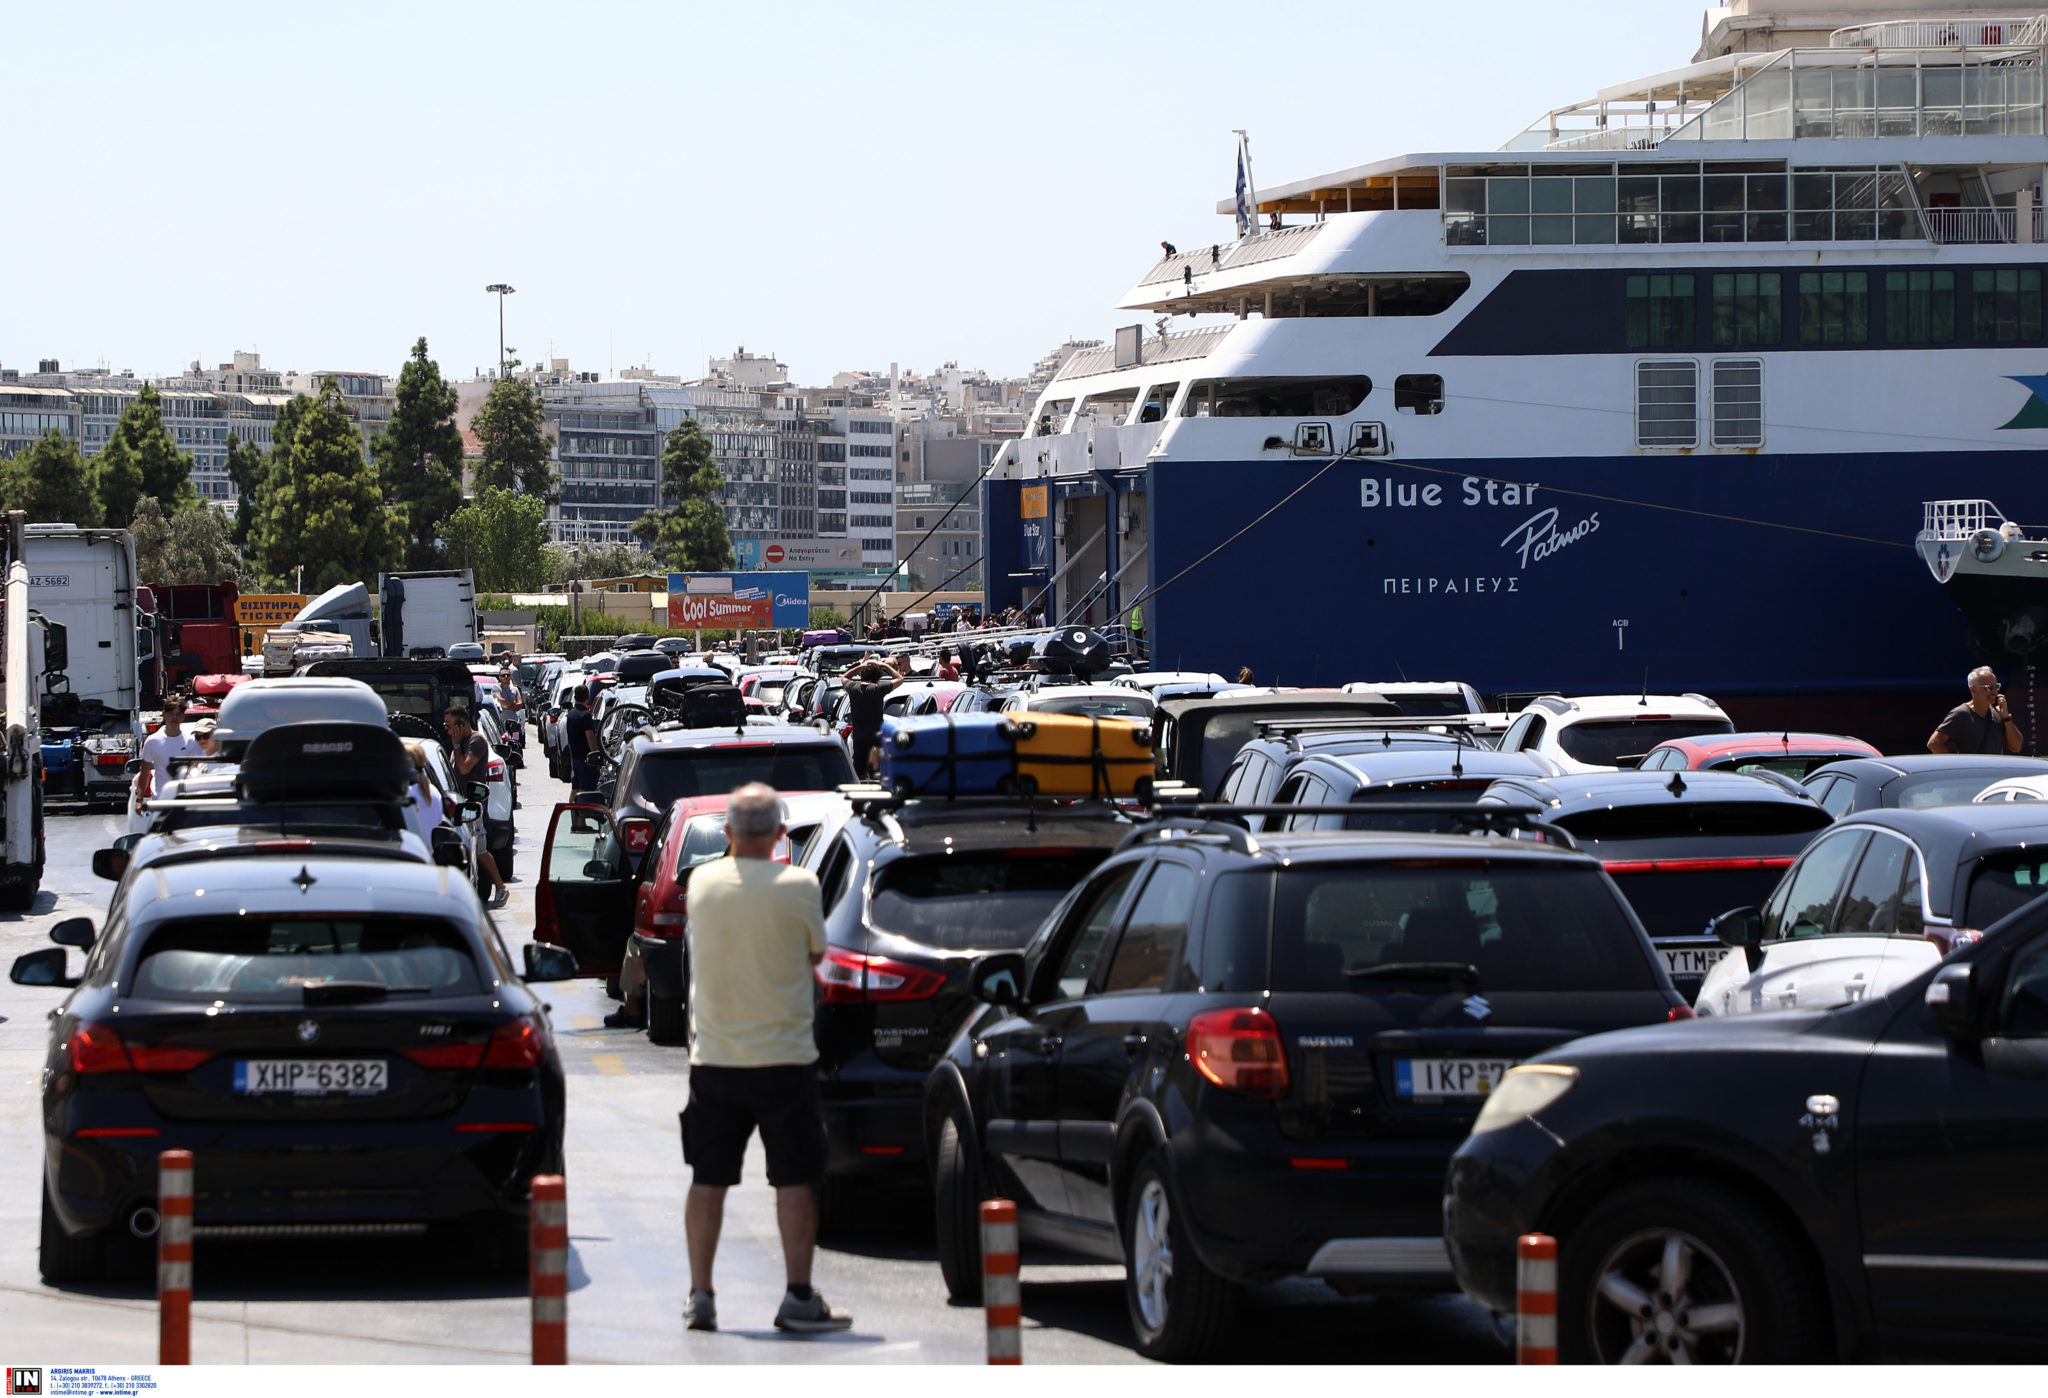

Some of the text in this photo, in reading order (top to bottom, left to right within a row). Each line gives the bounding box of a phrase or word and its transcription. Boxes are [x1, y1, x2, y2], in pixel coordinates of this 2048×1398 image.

[1361, 476, 1540, 507] Blue Star
[1500, 507, 1600, 570] Patmos
[737, 542, 754, 555] E8
[799, 555, 815, 563] Entry
[1384, 577, 1519, 594] ΠΕΙΡΑΙΕΥΣ
[240, 601, 300, 610] ΕΙΣΙΤΗΡΙΑ
[778, 595, 807, 606] Midea
[683, 595, 752, 622] Cool Summer
